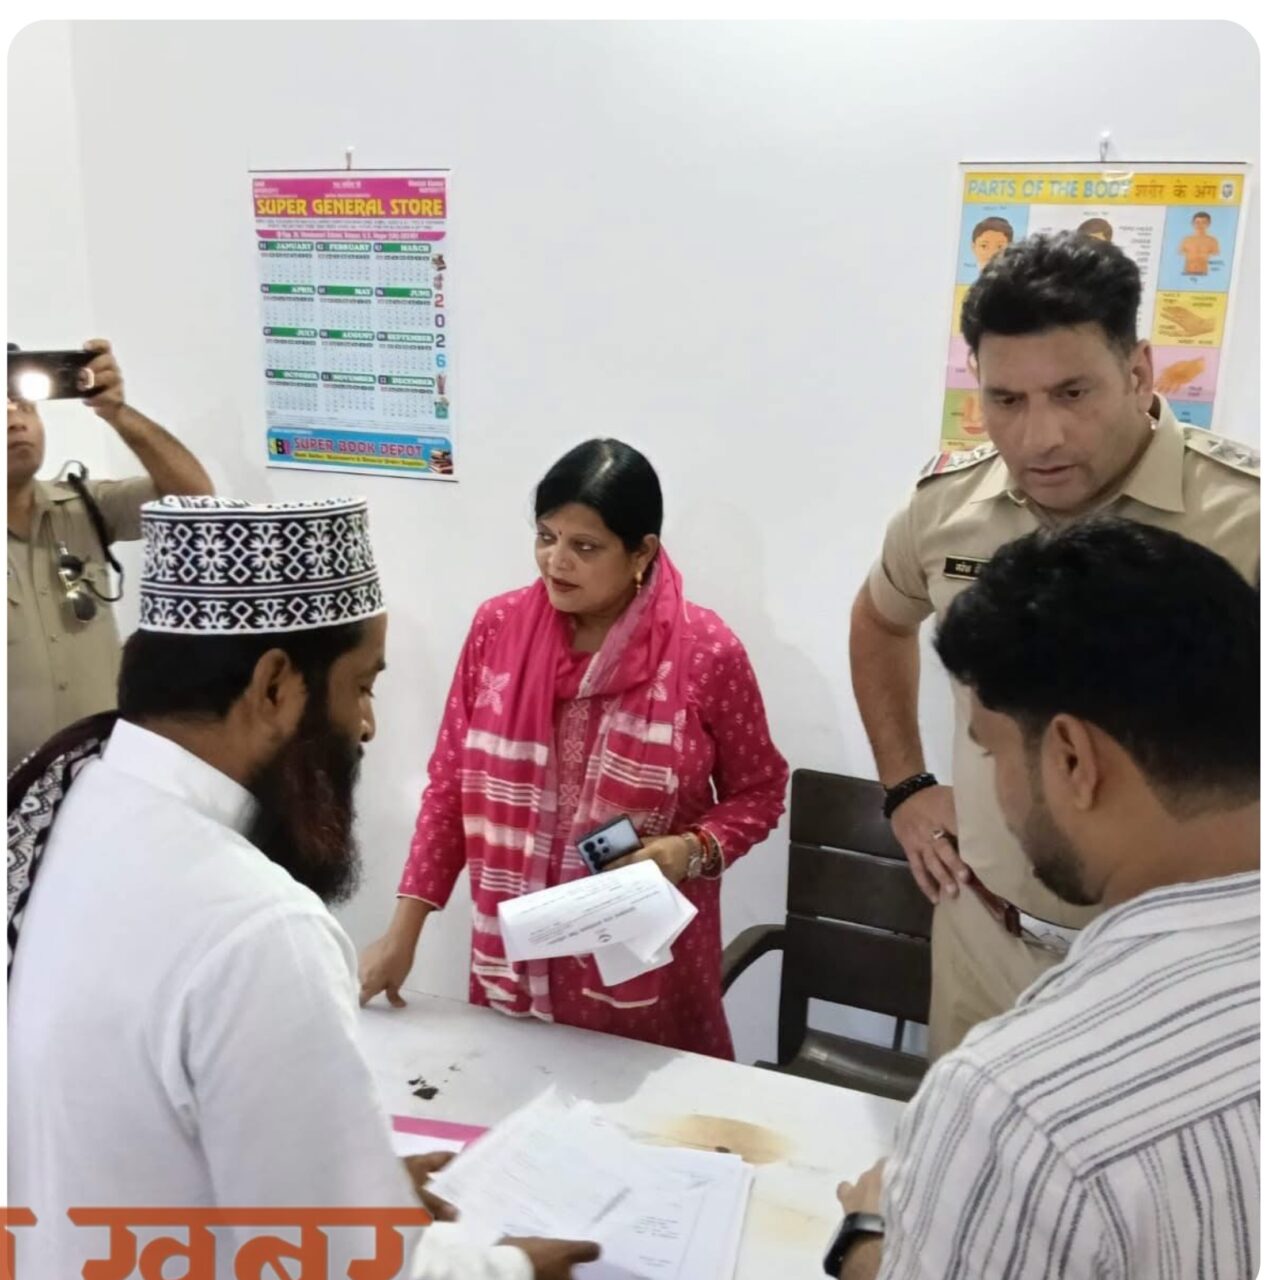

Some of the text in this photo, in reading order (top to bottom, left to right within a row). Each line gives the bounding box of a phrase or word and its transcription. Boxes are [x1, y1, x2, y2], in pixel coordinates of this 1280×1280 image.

[967, 179, 1016, 198] PARTS
[1022, 179, 1044, 198] OF
[1050, 179, 1080, 198] THE
[256, 198, 444, 217] SUPER GENERAL STORE
[294, 437, 334, 452] SUPER
[338, 440, 376, 455] BOOK
[380, 443, 424, 458] DEPOT
